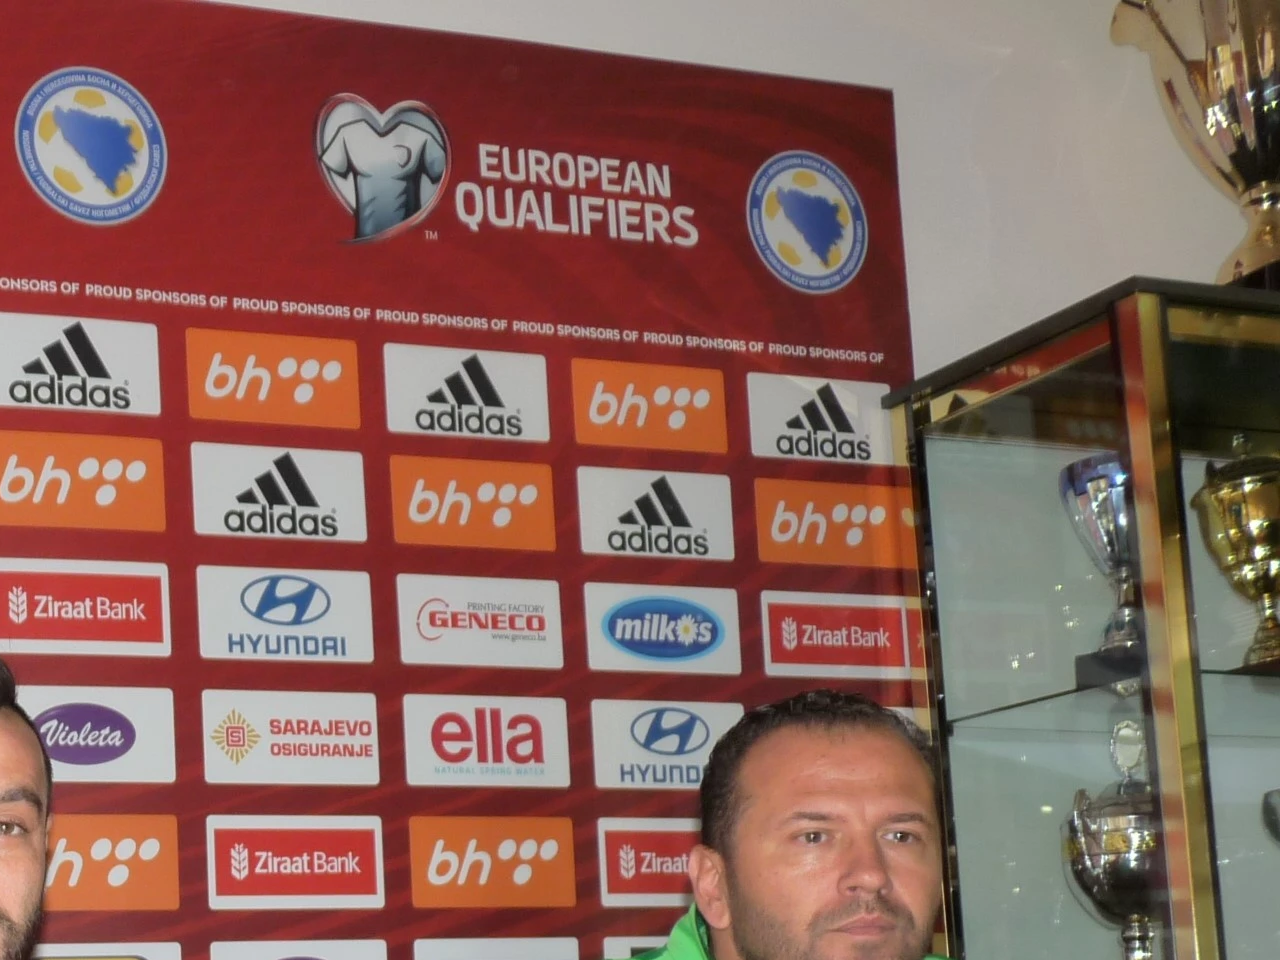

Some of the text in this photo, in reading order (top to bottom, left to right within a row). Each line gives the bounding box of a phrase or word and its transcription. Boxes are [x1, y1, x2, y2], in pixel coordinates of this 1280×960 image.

[478, 143, 672, 199] EUROPEAN
[455, 181, 699, 247] QUALIFIERS
[61, 282, 79, 294] OF
[86, 284, 132, 299] PROUD
[136, 288, 206, 306] SPONSORS
[210, 296, 227, 308] OF
[233, 298, 278, 311] PROUD
[282, 301, 350, 318] SPONSORS
[353, 308, 370, 319] OF
[376, 309, 419, 324] PROUD
[422, 313, 488, 330] SPONSORS
[491, 319, 507, 330] OF
[513, 321, 554, 334] PROUD
[557, 324, 620, 340] SPONSORS
[623, 330, 638, 342] OF
[644, 332, 683, 345] PROUD
[686, 336, 746, 352] SPONSORS
[749, 342, 763, 352] OF
[769, 343, 807, 356] PROUD
[809, 347, 867, 362] SPONSORS
[869, 352, 884, 363] OF
[9, 374, 131, 410] adidas
[416, 403, 522, 436] adidas
[776, 430, 871, 461] adidas
[224, 504, 338, 537] adidas
[608, 525, 709, 555] adidas
[34, 596, 145, 620] Ziraat Bank
[429, 611, 546, 631] GENECO
[467, 602, 545, 613] PRINTING FACTORY
[228, 633, 347, 657] HYUNDAI
[802, 626, 890, 647] Ziraat Bank
[39, 718, 125, 748] Violeta
[270, 719, 372, 736] SARAJEVO
[431, 707, 545, 764] ella
[271, 743, 373, 757] OSIGURANJE
[434, 765, 545, 776] NATURAL SPRING WATER
[620, 764, 700, 784] HYUND
[45, 838, 84, 887] h
[254, 852, 361, 874] Ziraat Bank
[640, 852, 689, 874] Ziraat
